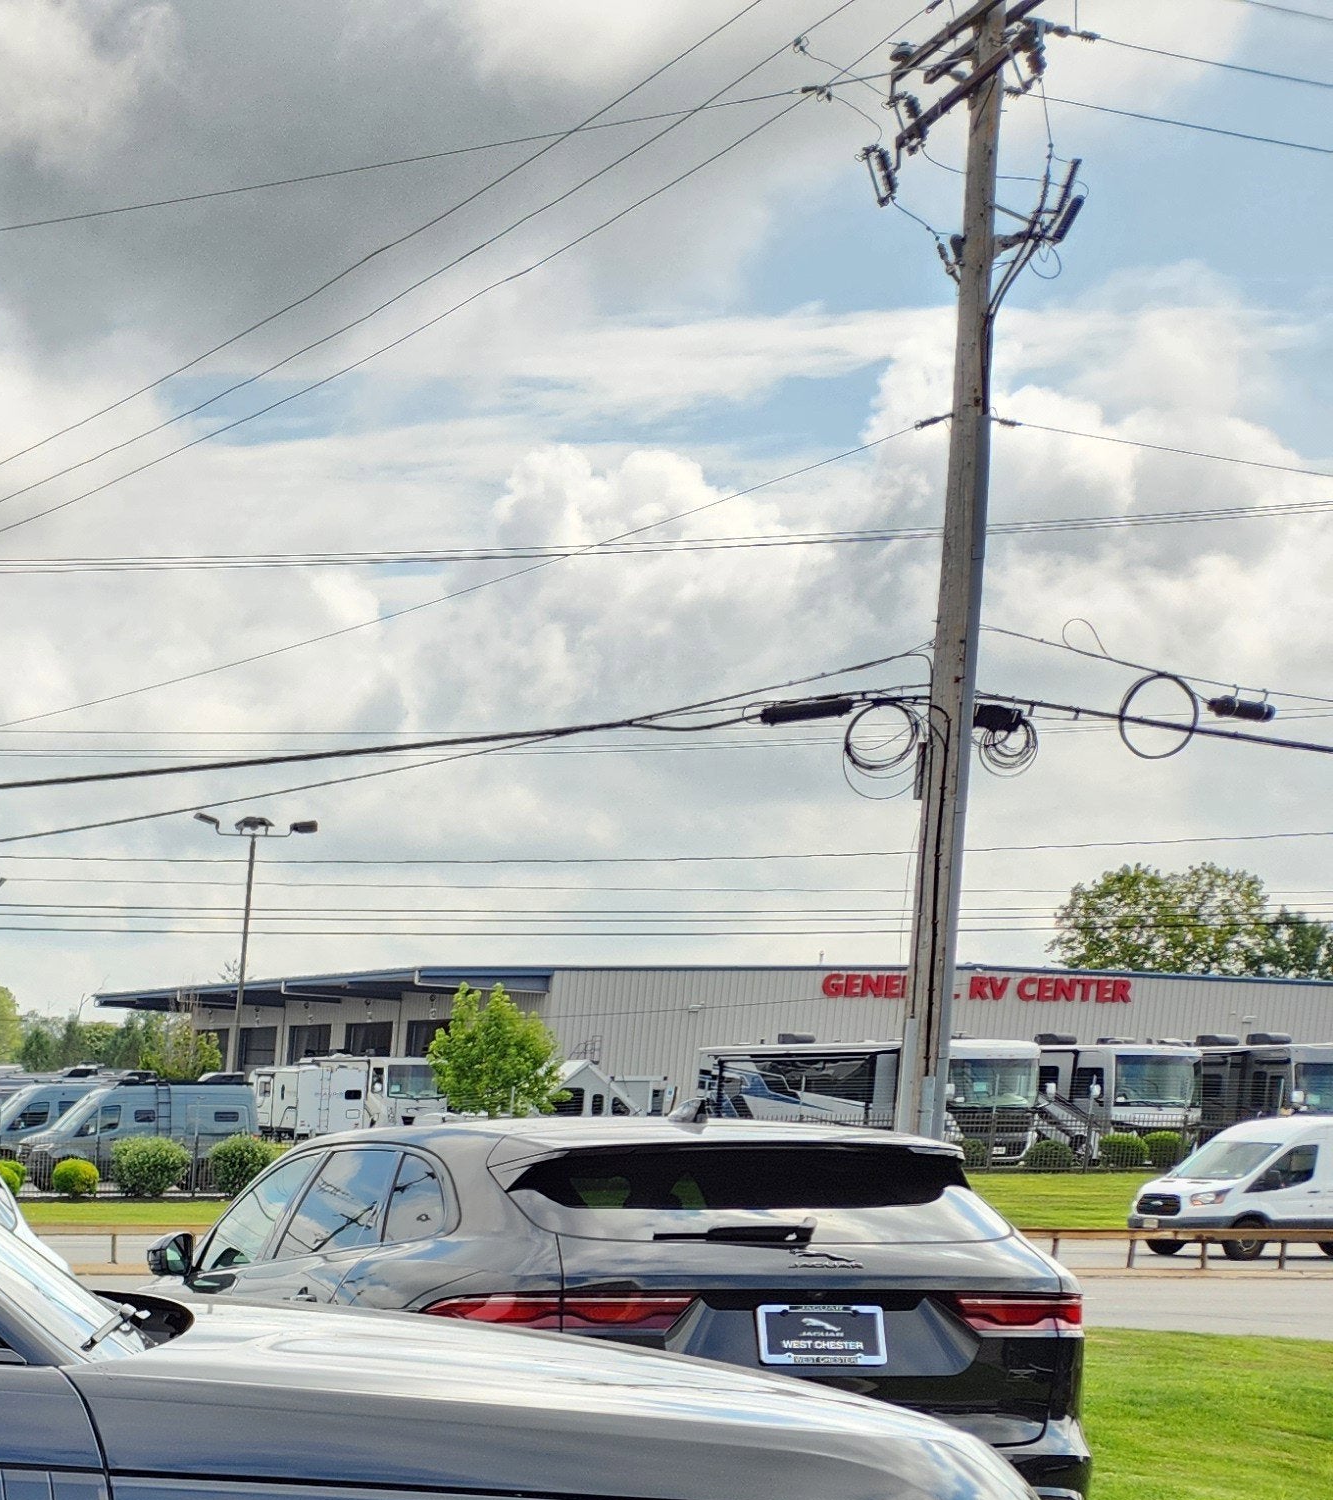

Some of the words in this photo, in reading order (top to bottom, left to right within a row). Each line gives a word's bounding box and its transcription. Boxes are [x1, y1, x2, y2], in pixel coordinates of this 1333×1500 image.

[822, 973, 960, 998] GENE
[969, 976, 1010, 1000] RV
[1017, 977, 1132, 1003] CENTER
[788, 1261, 864, 1269] JAGUAR
[782, 1340, 813, 1349] WEST
[814, 1341, 864, 1350] CHESTER
[816, 1356, 859, 1364] CHESTER
